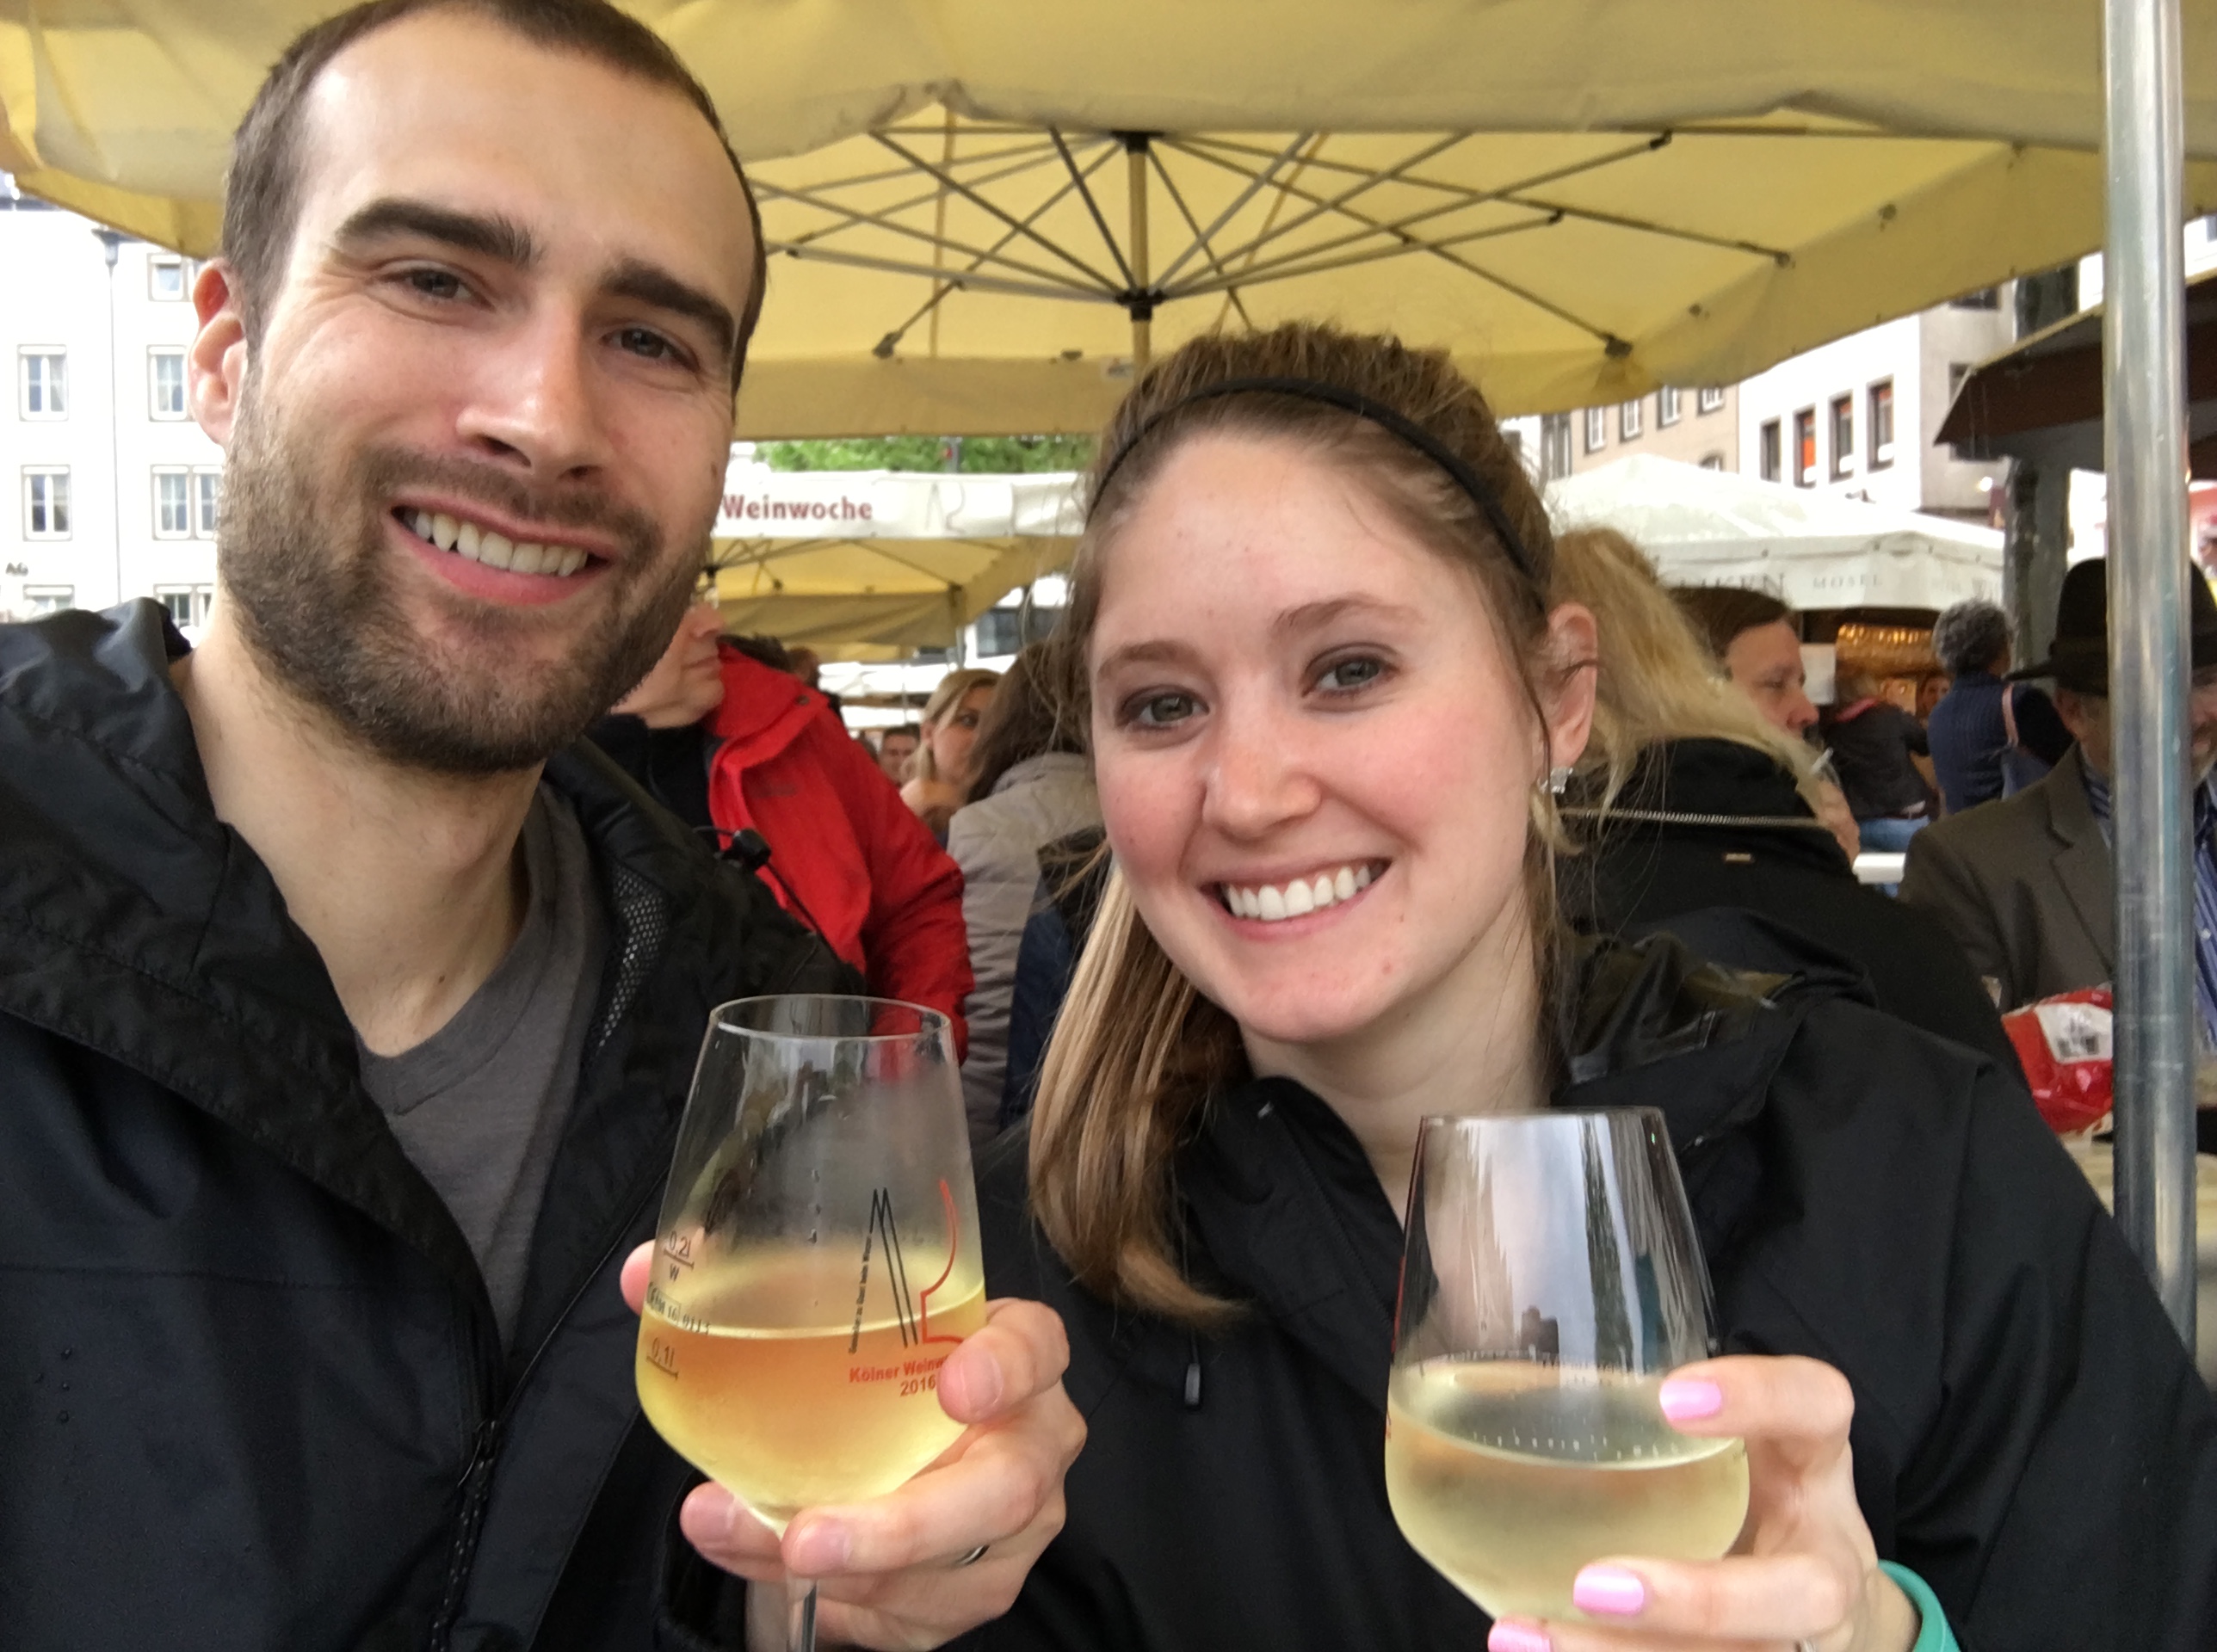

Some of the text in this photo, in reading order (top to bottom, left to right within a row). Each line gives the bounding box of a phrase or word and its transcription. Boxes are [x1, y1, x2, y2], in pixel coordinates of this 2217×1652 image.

[723, 494, 873, 520] Weinwoche
[904, 1354, 948, 1376] Weinw
[900, 1374, 936, 1396] 2016
